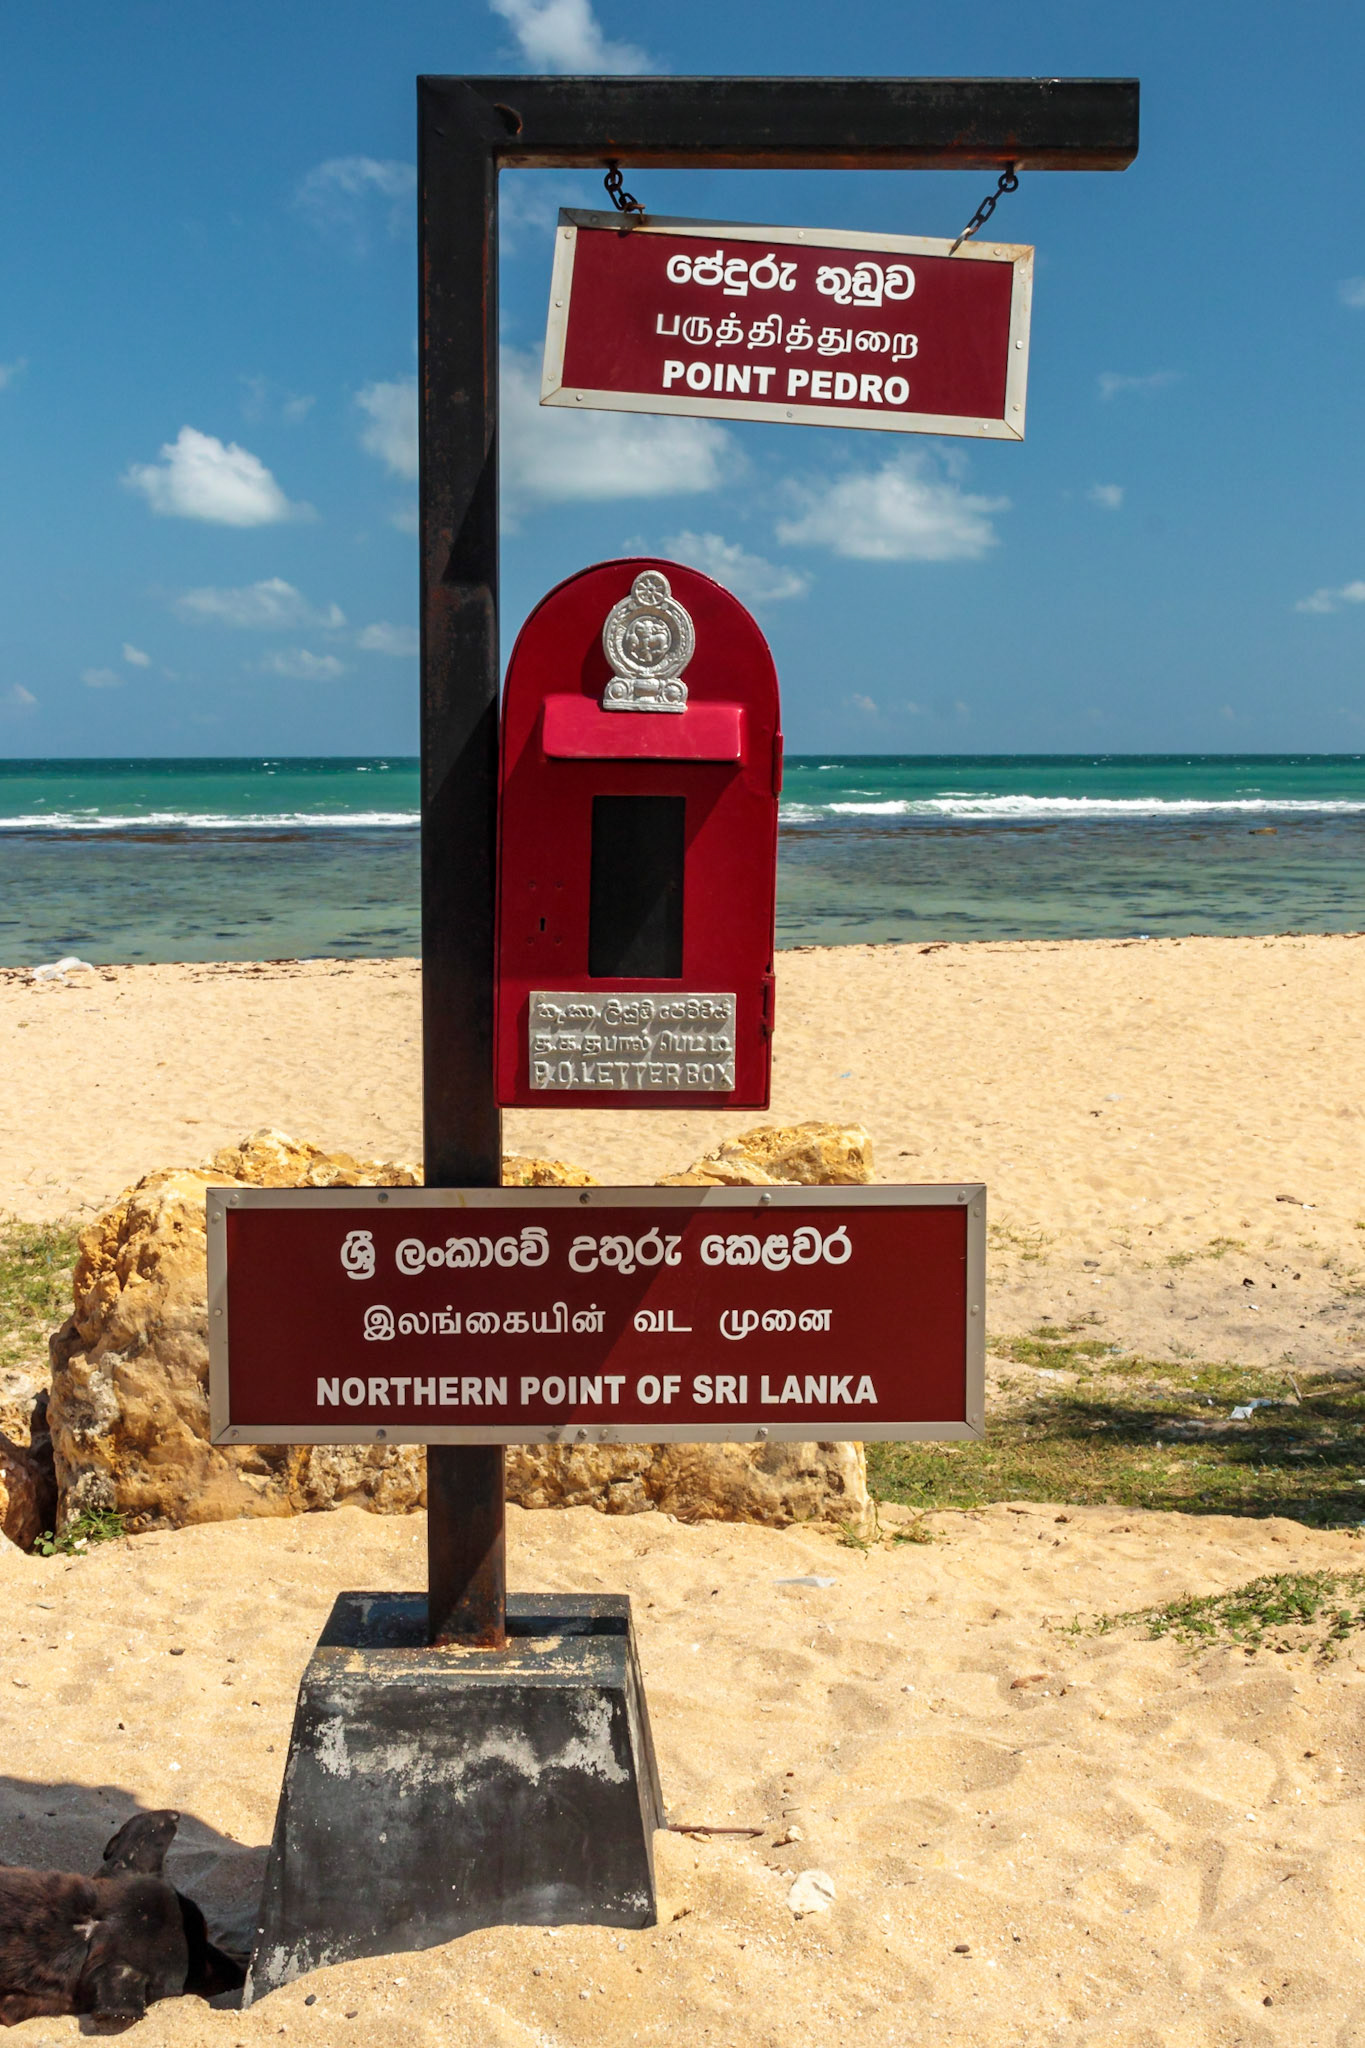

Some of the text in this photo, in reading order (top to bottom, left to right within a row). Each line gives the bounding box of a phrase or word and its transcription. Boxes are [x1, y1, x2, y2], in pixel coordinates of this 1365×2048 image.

[667, 250, 915, 307] පේදුරු තුඩුව
[656, 312, 918, 362] பருத்தித்துறை
[662, 360, 909, 404] POINT PEDRO
[685, 1063, 733, 1086] BOX
[395, 1227, 549, 1275] ලංකාවේ
[568, 1227, 681, 1275] උතුරු
[700, 1226, 852, 1271] කෙළවර
[363, 1302, 832, 1341] இலங்கையின் வட முனை
[317, 1375, 877, 1405] NORTHERN POINT OF SRI LANKA
